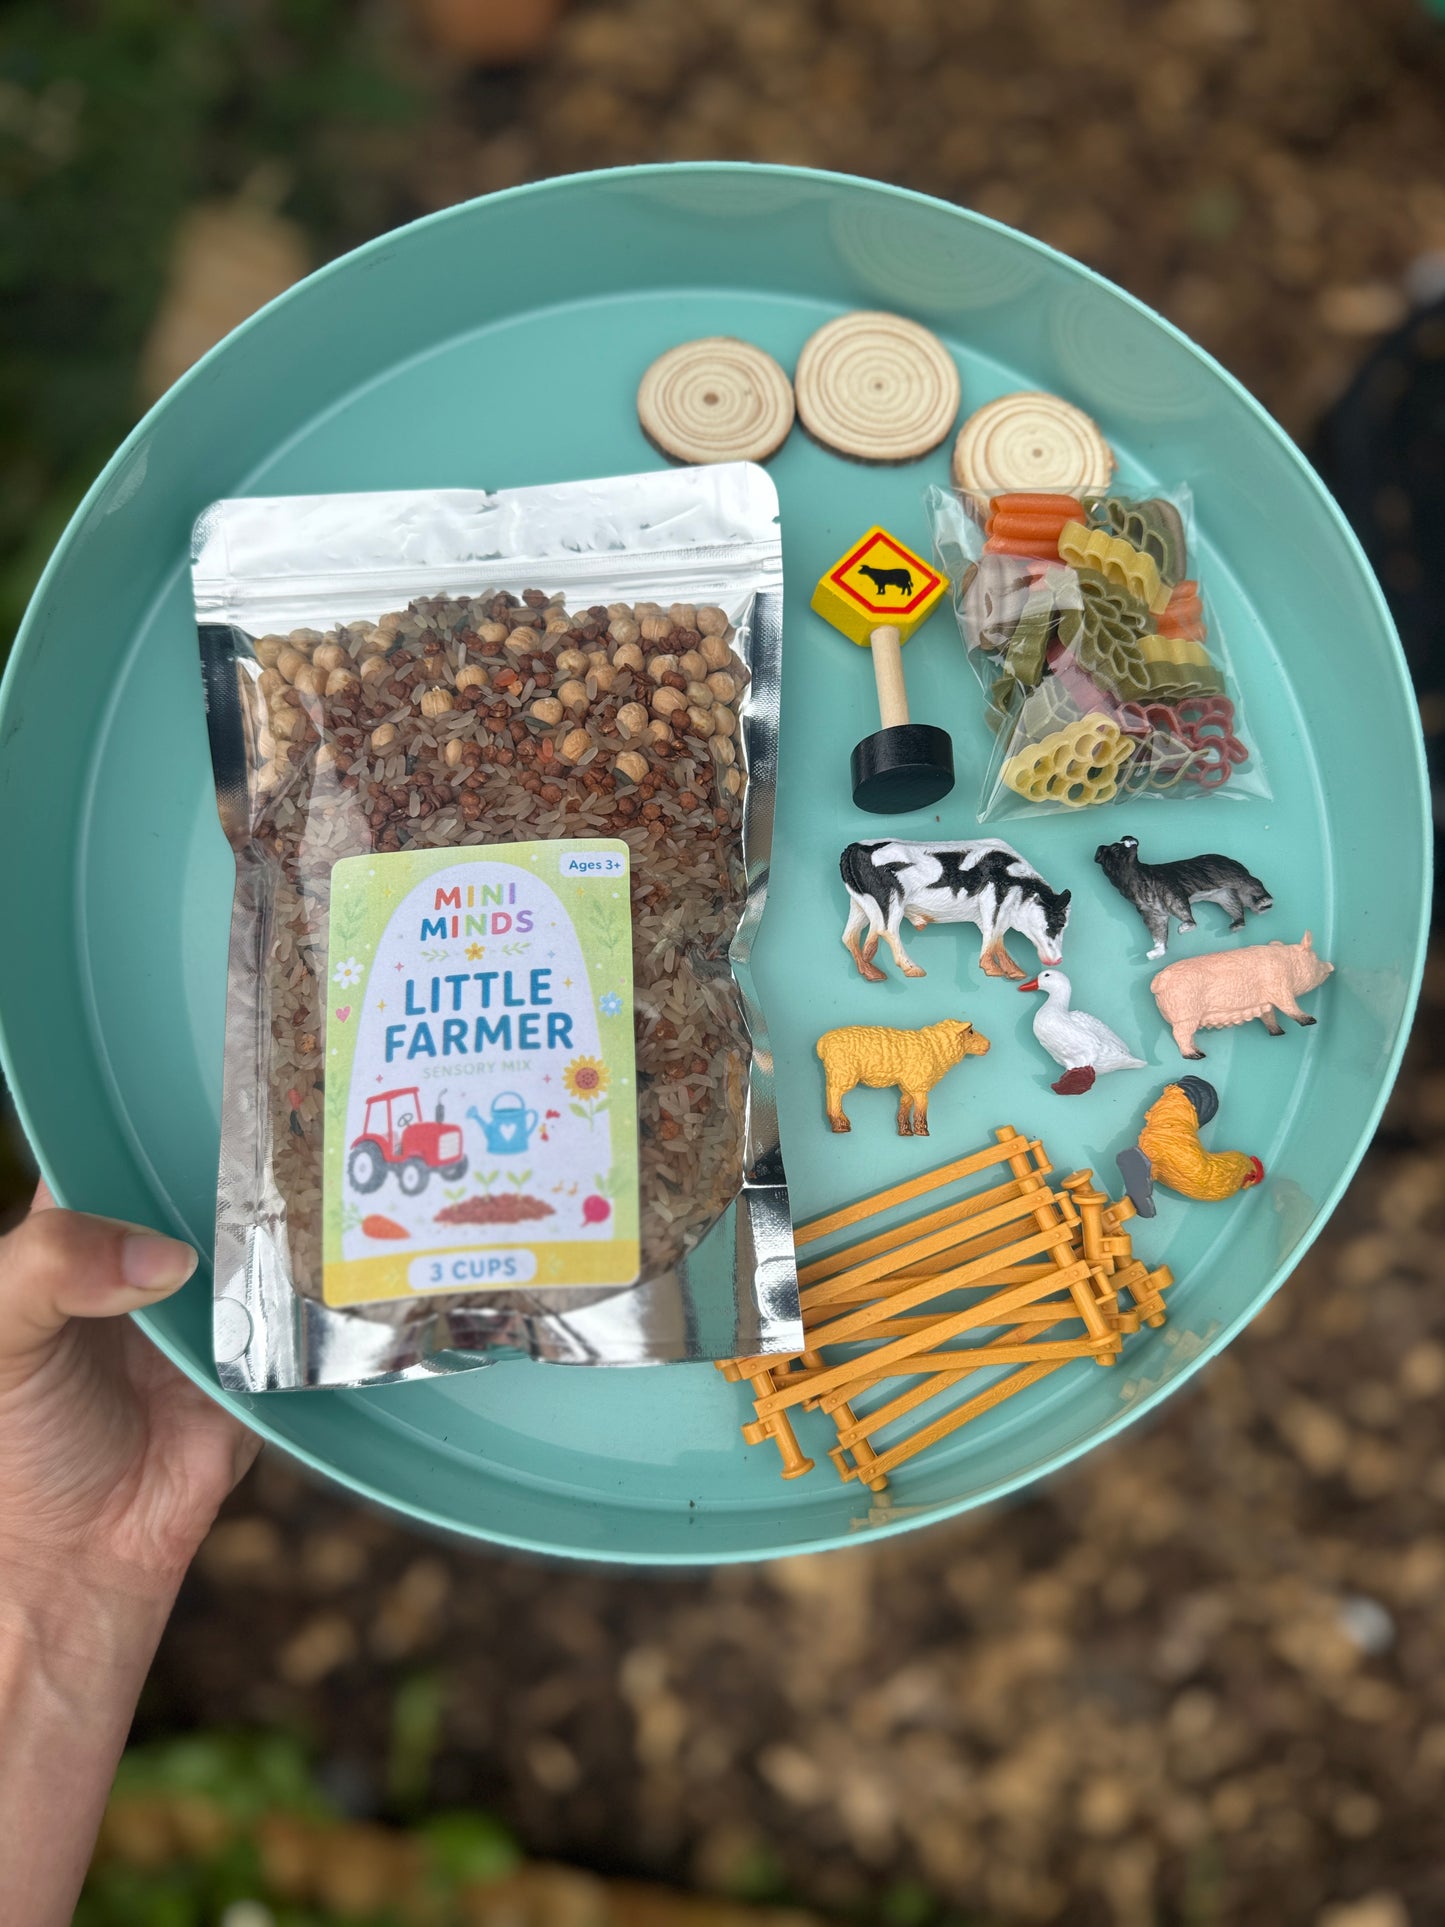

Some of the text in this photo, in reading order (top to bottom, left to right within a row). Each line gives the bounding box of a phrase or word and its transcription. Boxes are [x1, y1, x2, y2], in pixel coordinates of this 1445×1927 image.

[568, 859, 622, 873] Ages 3+
[434, 882, 516, 910] MINI
[420, 910, 534, 941] MINDS
[405, 968, 553, 1016] LITTLE
[385, 1012, 574, 1063] FARMER
[423, 1059, 532, 1079] SENSORY MIX
[430, 1257, 518, 1282] 3 CUPS
